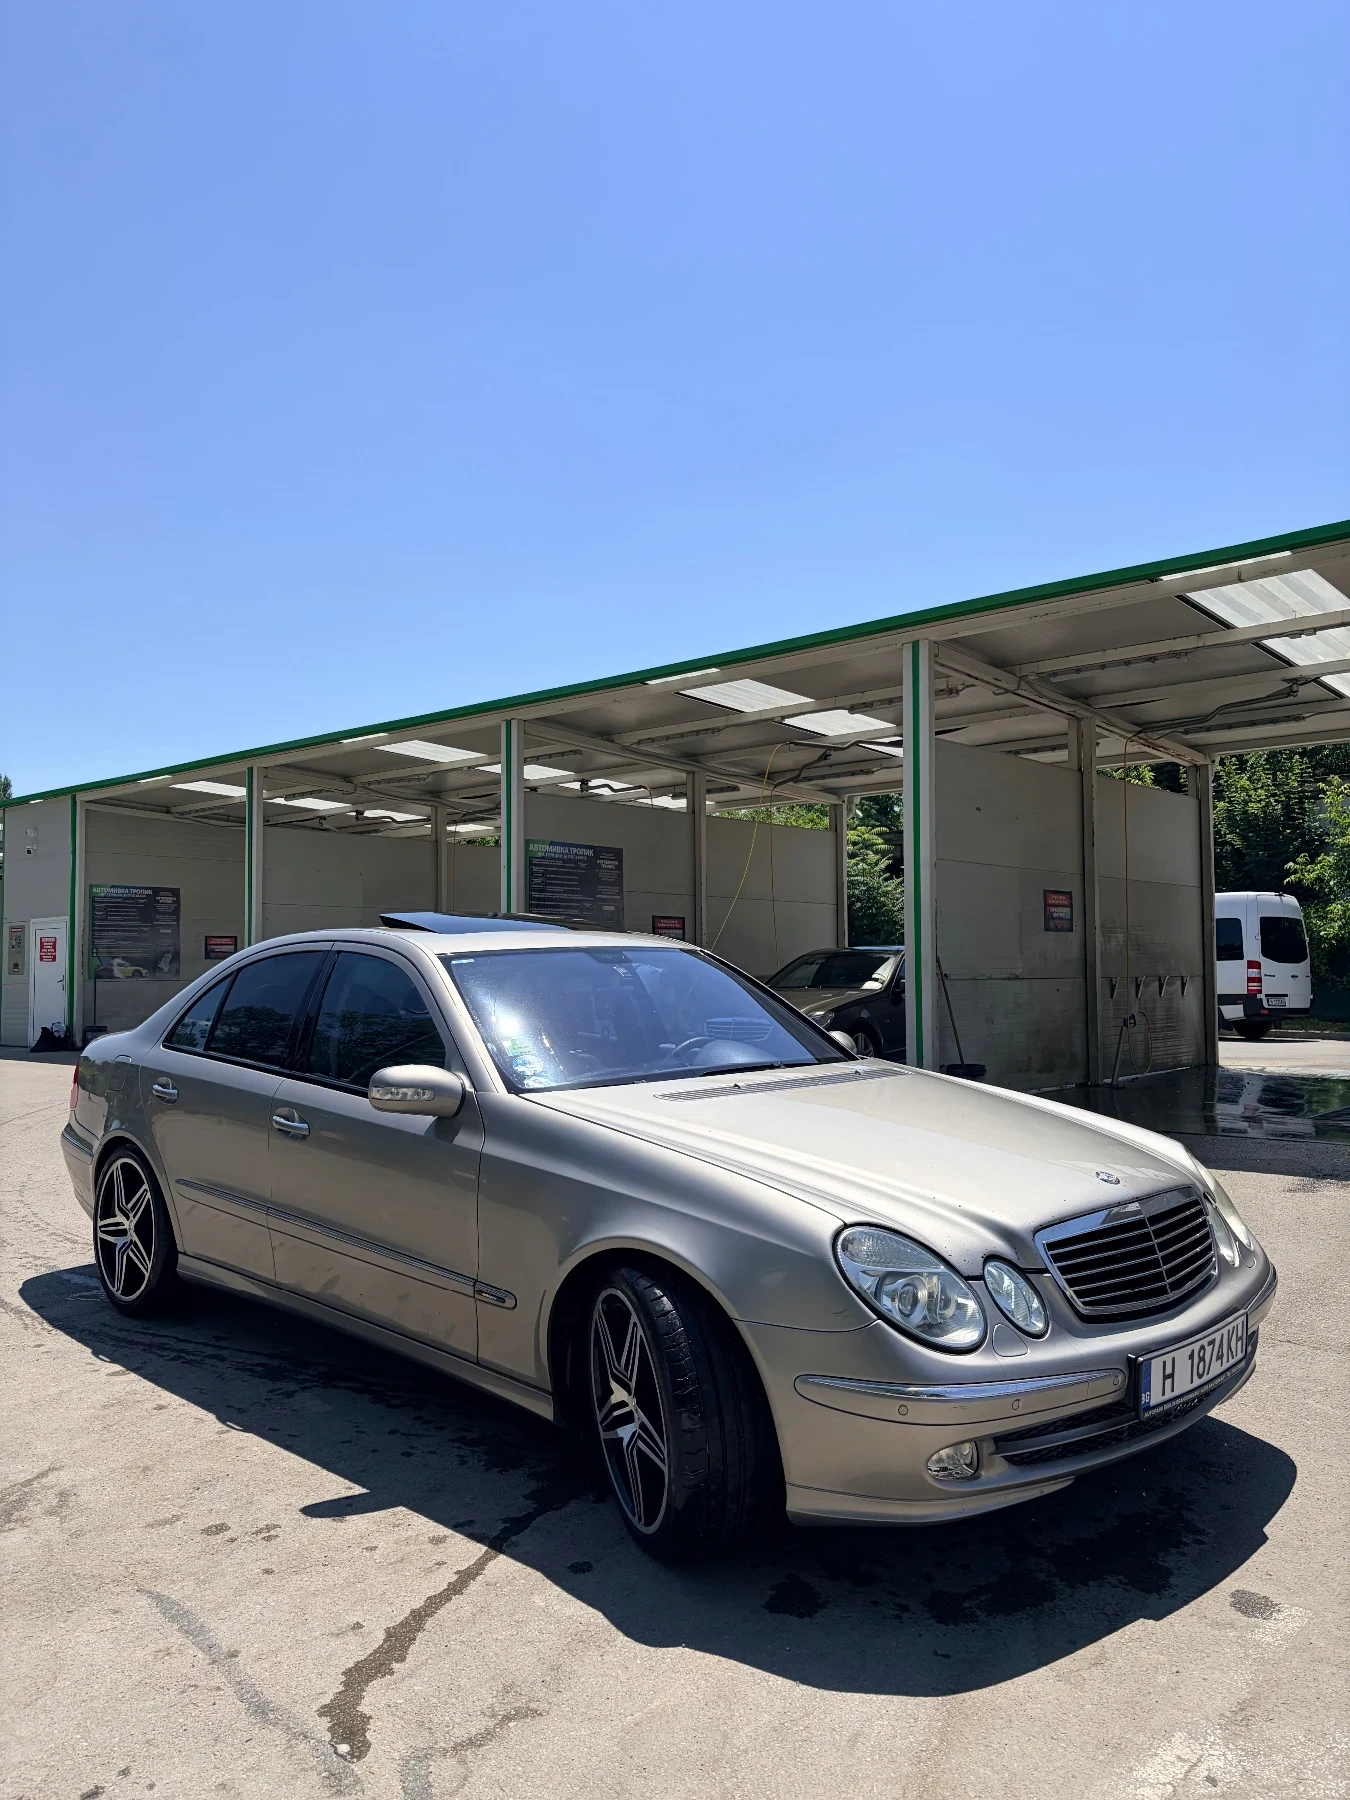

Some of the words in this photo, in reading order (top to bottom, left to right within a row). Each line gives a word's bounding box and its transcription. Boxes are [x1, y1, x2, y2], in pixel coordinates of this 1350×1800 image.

[529, 843, 569, 853] АВТОМИВКА
[569, 847, 594, 856] ТРОПИК
[1161, 1356, 1176, 1397] H
